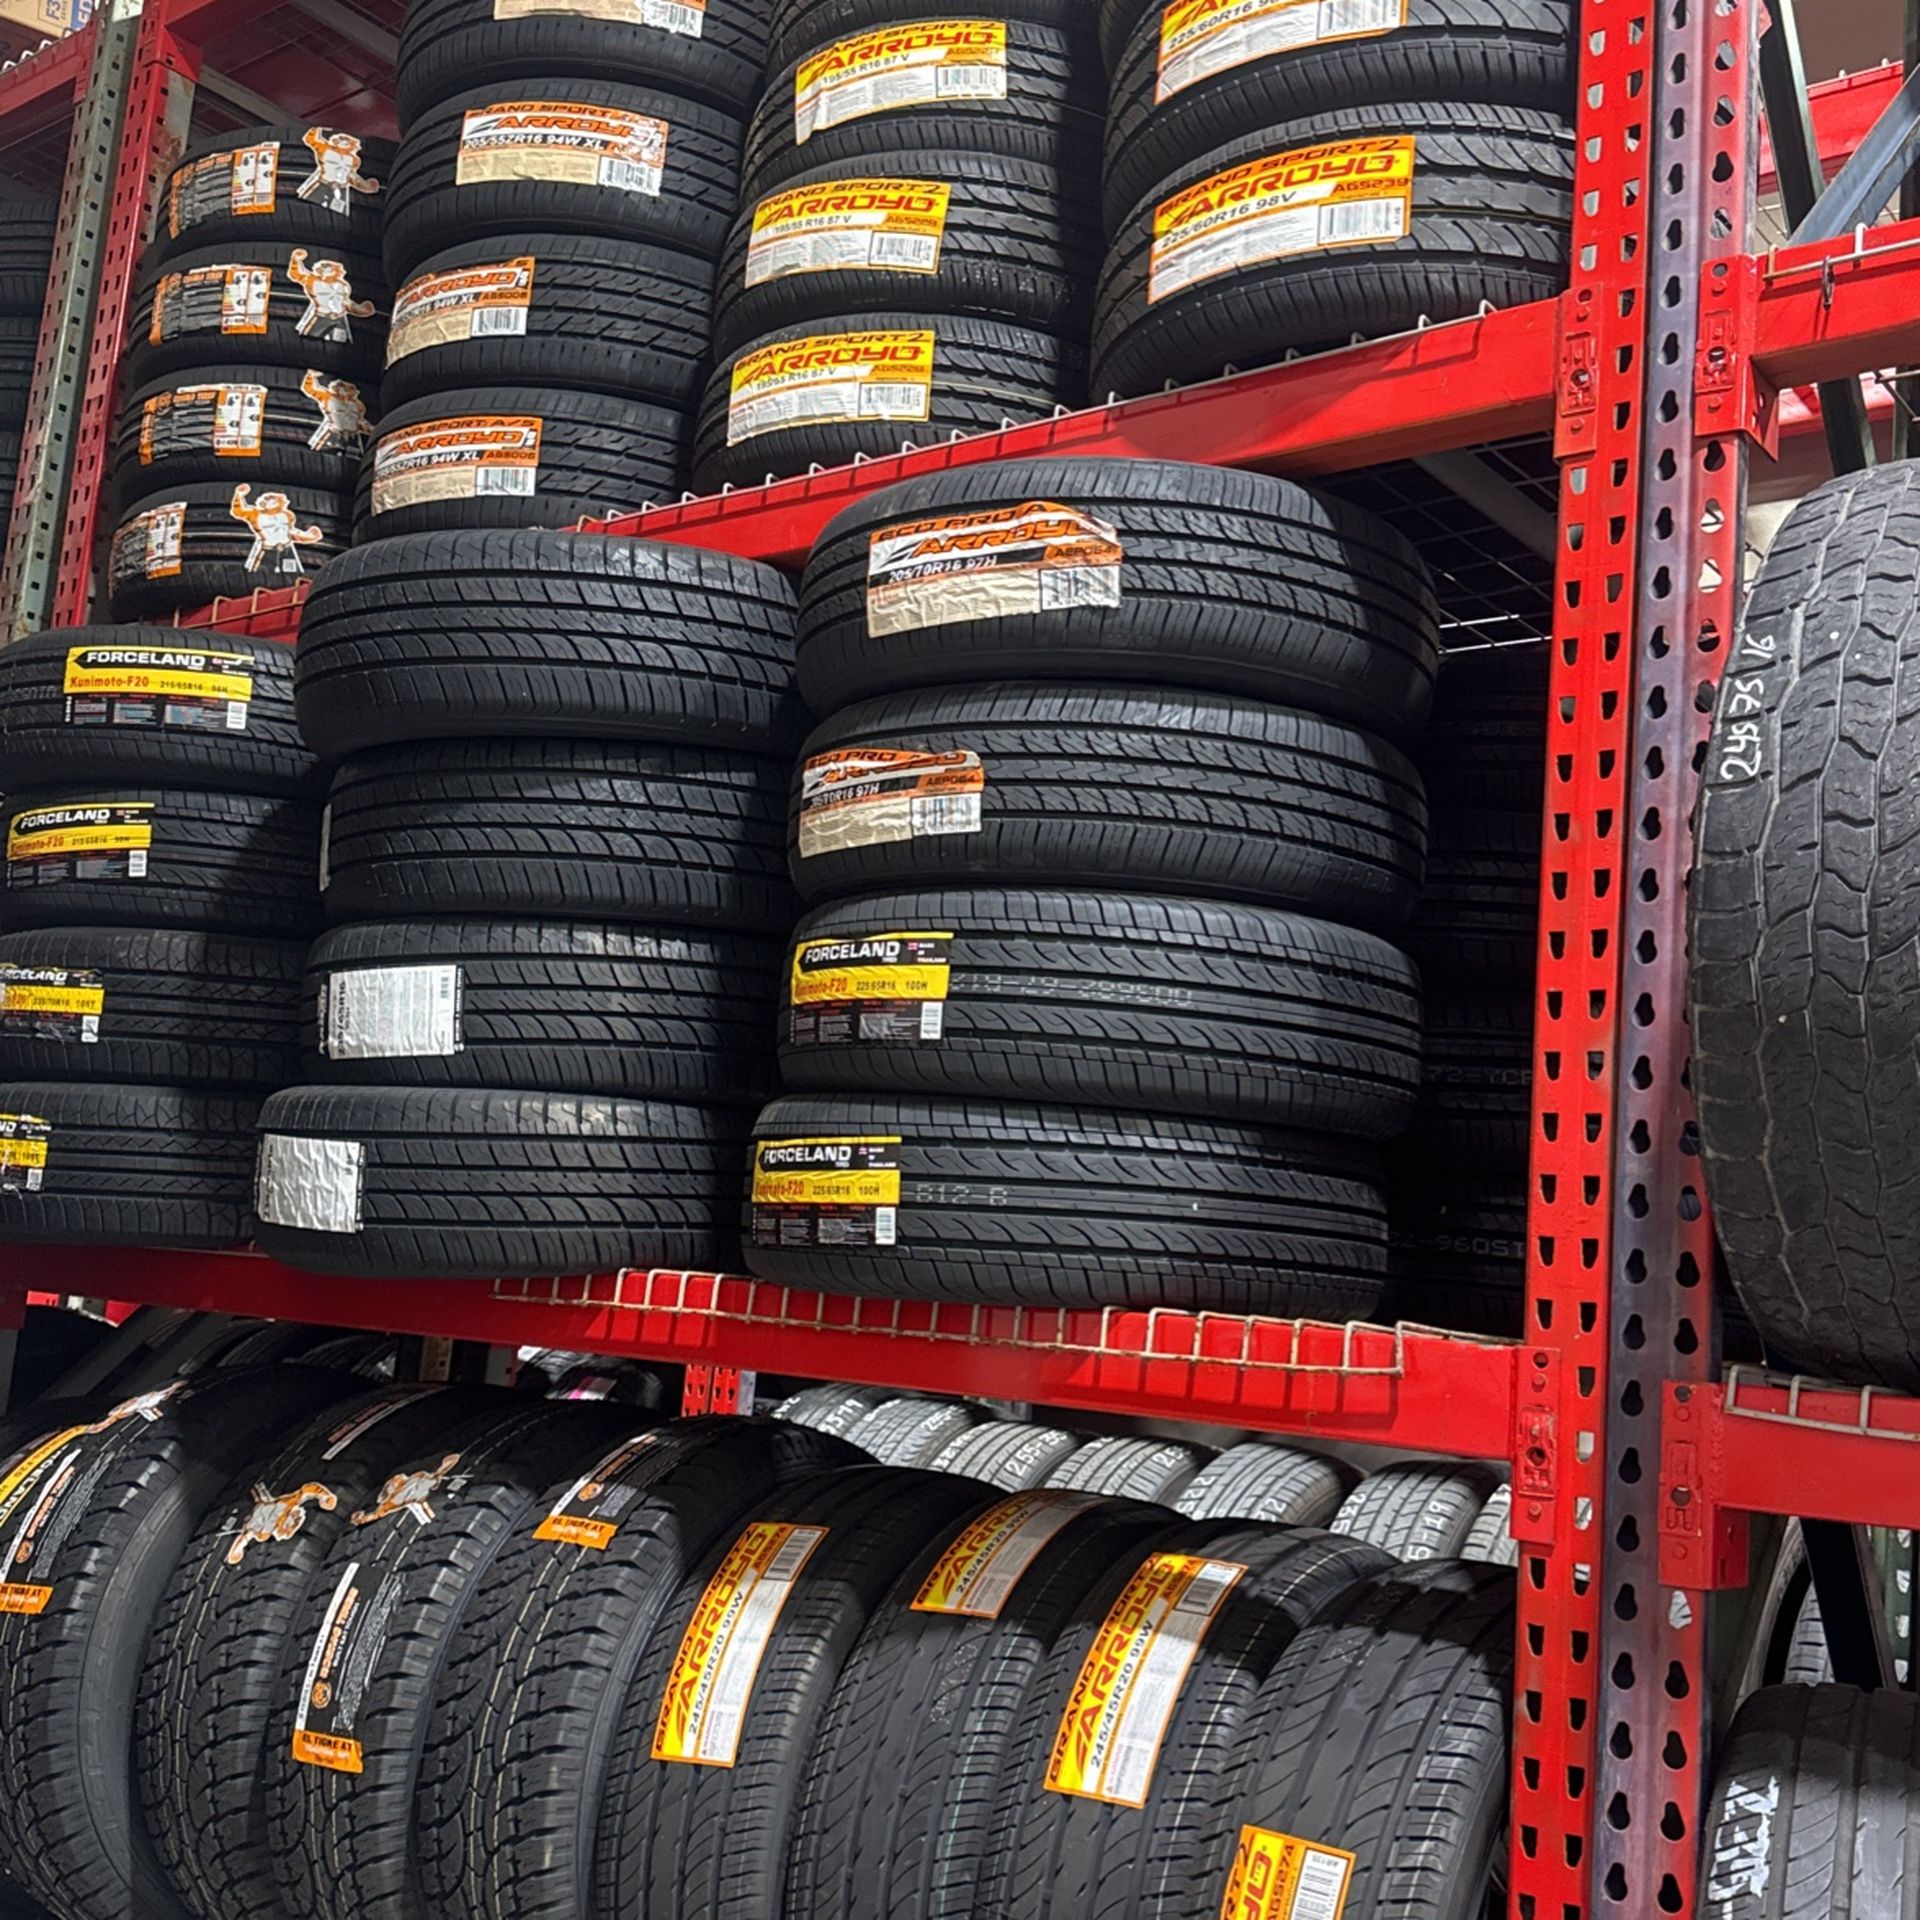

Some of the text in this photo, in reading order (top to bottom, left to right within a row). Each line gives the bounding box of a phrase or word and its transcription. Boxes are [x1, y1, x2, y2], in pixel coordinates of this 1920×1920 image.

[824, 31, 995, 72] ARROYO
[584, 138, 605, 151] XL
[1158, 168, 1254, 218] GRAND
[1258, 143, 1378, 172] SPORT
[1187, 154, 1398, 221] ARROYO
[757, 186, 828, 214] GRAND
[830, 182, 919, 193] SPORT
[774, 194, 938, 223] ARROYO
[805, 218, 827, 228] R16
[842, 215, 853, 225] V
[1161, 191, 1298, 249] 225/60R16 98V
[460, 293, 478, 305] XL
[735, 342, 807, 372] GRAND
[814, 332, 906, 348] SPORT
[756, 345, 923, 379] ARROYO
[393, 430, 524, 457] ARROYO
[461, 451, 481, 461] XL
[86, 651, 206, 666] FORCELAND
[69, 676, 151, 689] Kunimoto-F20
[844, 750, 897, 761] PRO
[19, 808, 112, 830] FORCELAND
[804, 940, 901, 965] FORCELAND
[763, 1146, 852, 1164] FORCELAND
[917, 1529, 974, 1606] GRAND
[956, 1529, 1008, 1594] 245/45R20
[677, 1529, 768, 1714] ARROYO
[688, 1591, 744, 1736] 245/45R20 99W
[1078, 1563, 1175, 1742] ARROYO
[655, 1635, 693, 1753] GRAND
[1090, 1620, 1155, 1768] 245/45R20 99W
[1049, 1660, 1096, 1783] GRAND
